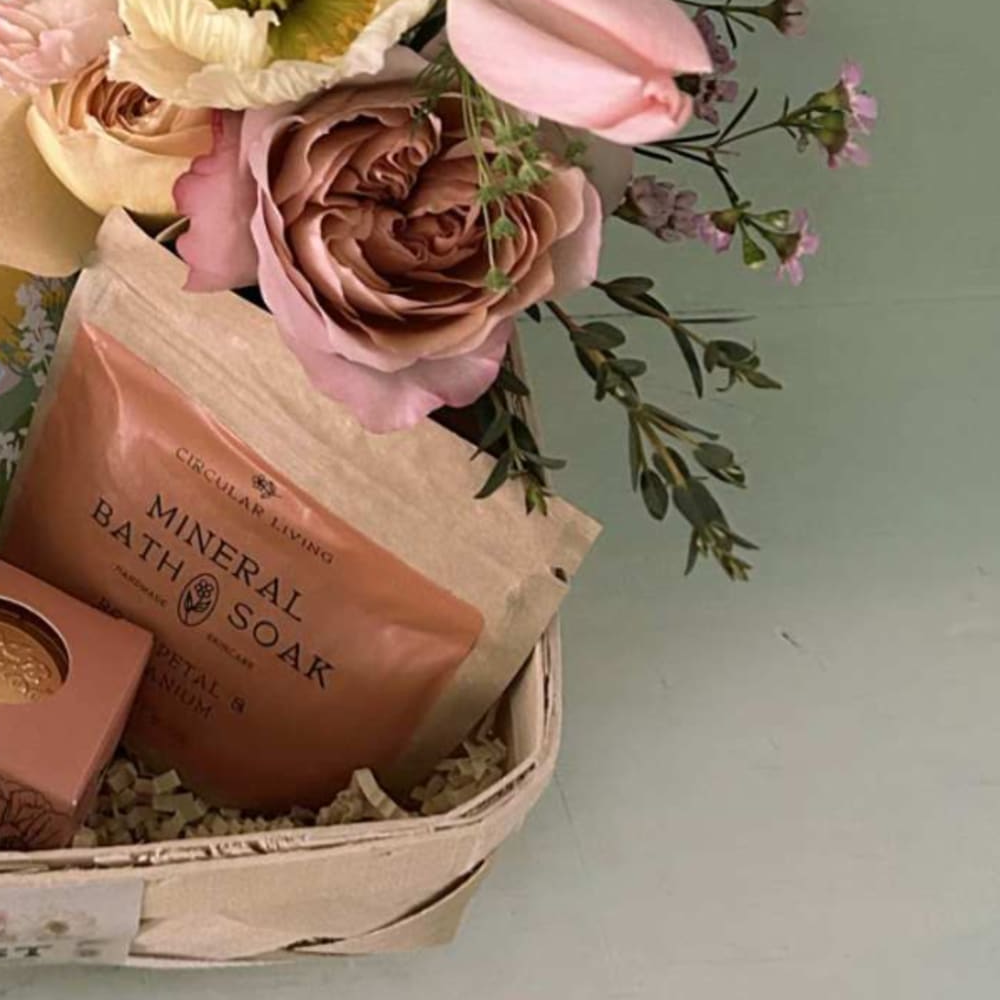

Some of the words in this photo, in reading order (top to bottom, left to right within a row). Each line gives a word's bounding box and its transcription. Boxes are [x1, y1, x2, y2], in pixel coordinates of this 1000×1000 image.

[145, 493, 305, 624] MINERAL
[174, 447, 265, 519] CIRCULAR
[269, 517, 336, 566] LIVING
[89, 498, 186, 583] BATH
[227, 602, 338, 690] SOAK
[154, 642, 219, 699] PETAL
